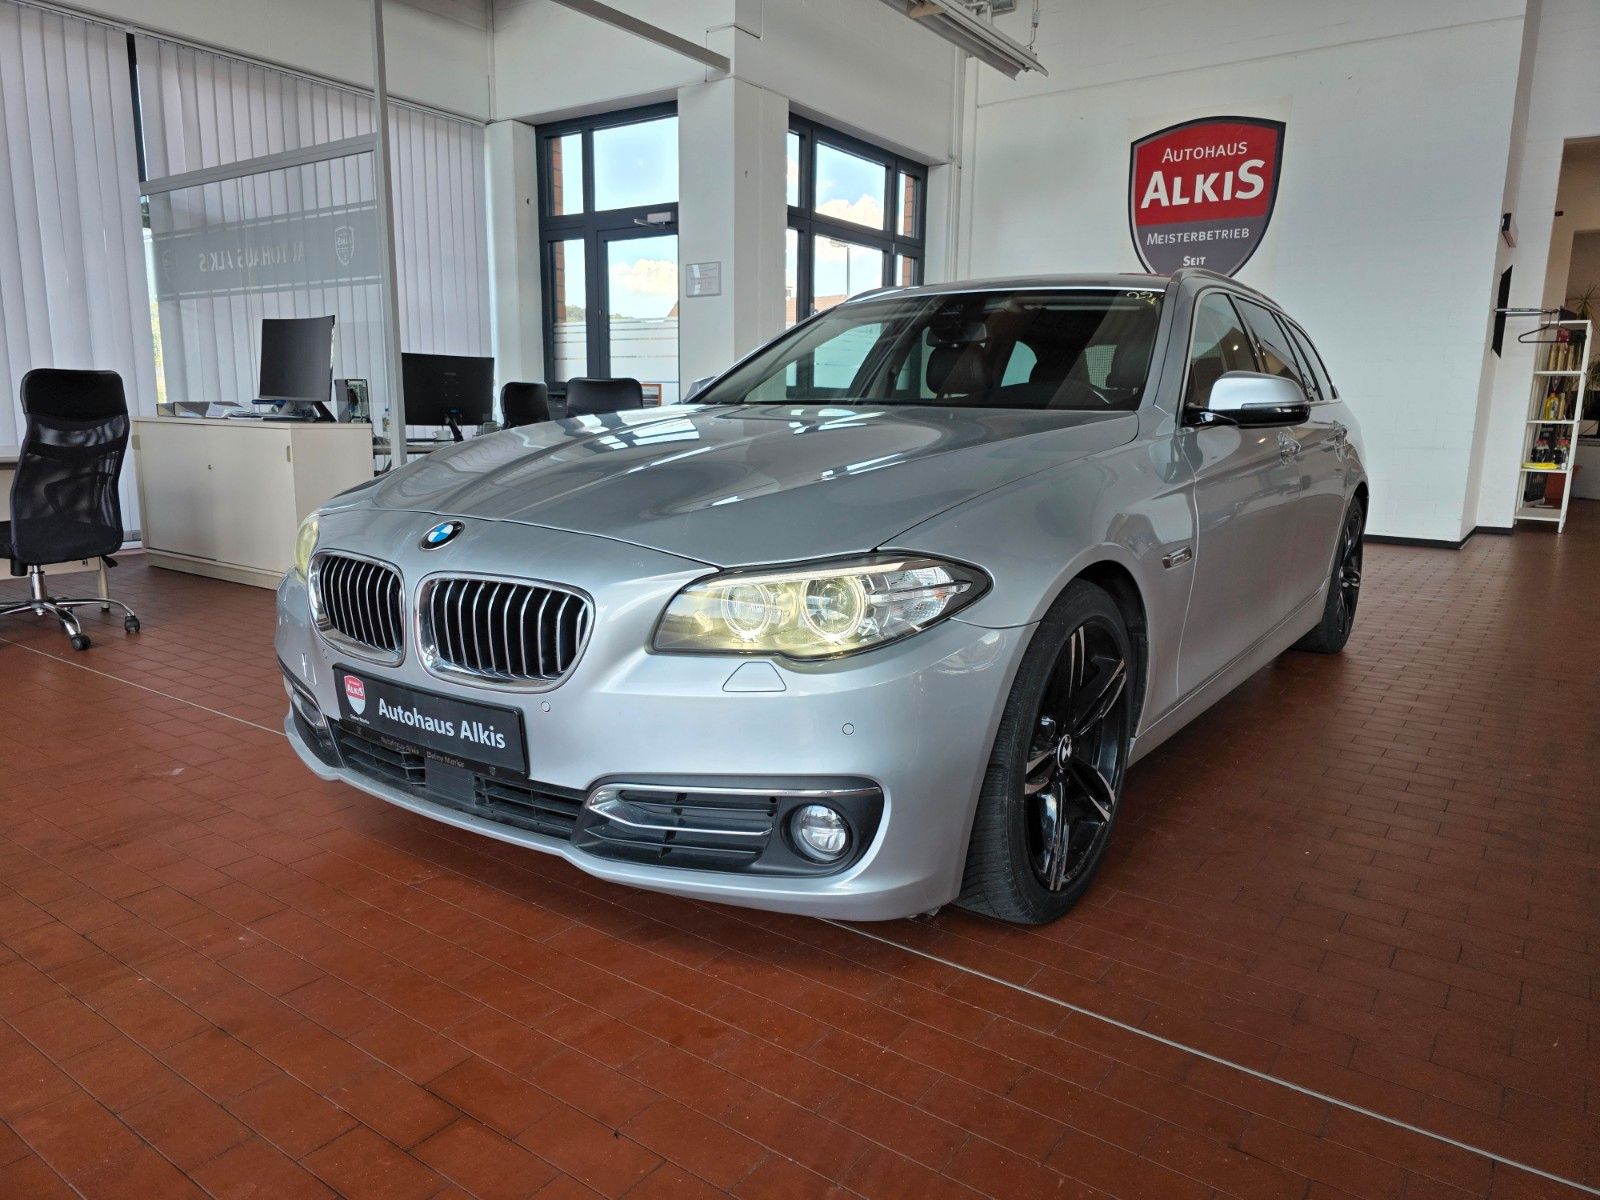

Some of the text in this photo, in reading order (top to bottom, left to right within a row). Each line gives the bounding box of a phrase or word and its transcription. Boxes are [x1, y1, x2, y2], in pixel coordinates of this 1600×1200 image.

[1162, 141, 1248, 164] AUTOHAUS
[1140, 158, 1265, 209] ALKIS
[1146, 228, 1249, 246] MEISTERBETRIEB
[378, 697, 455, 737] Autohaus
[460, 720, 506, 749] Alkis
